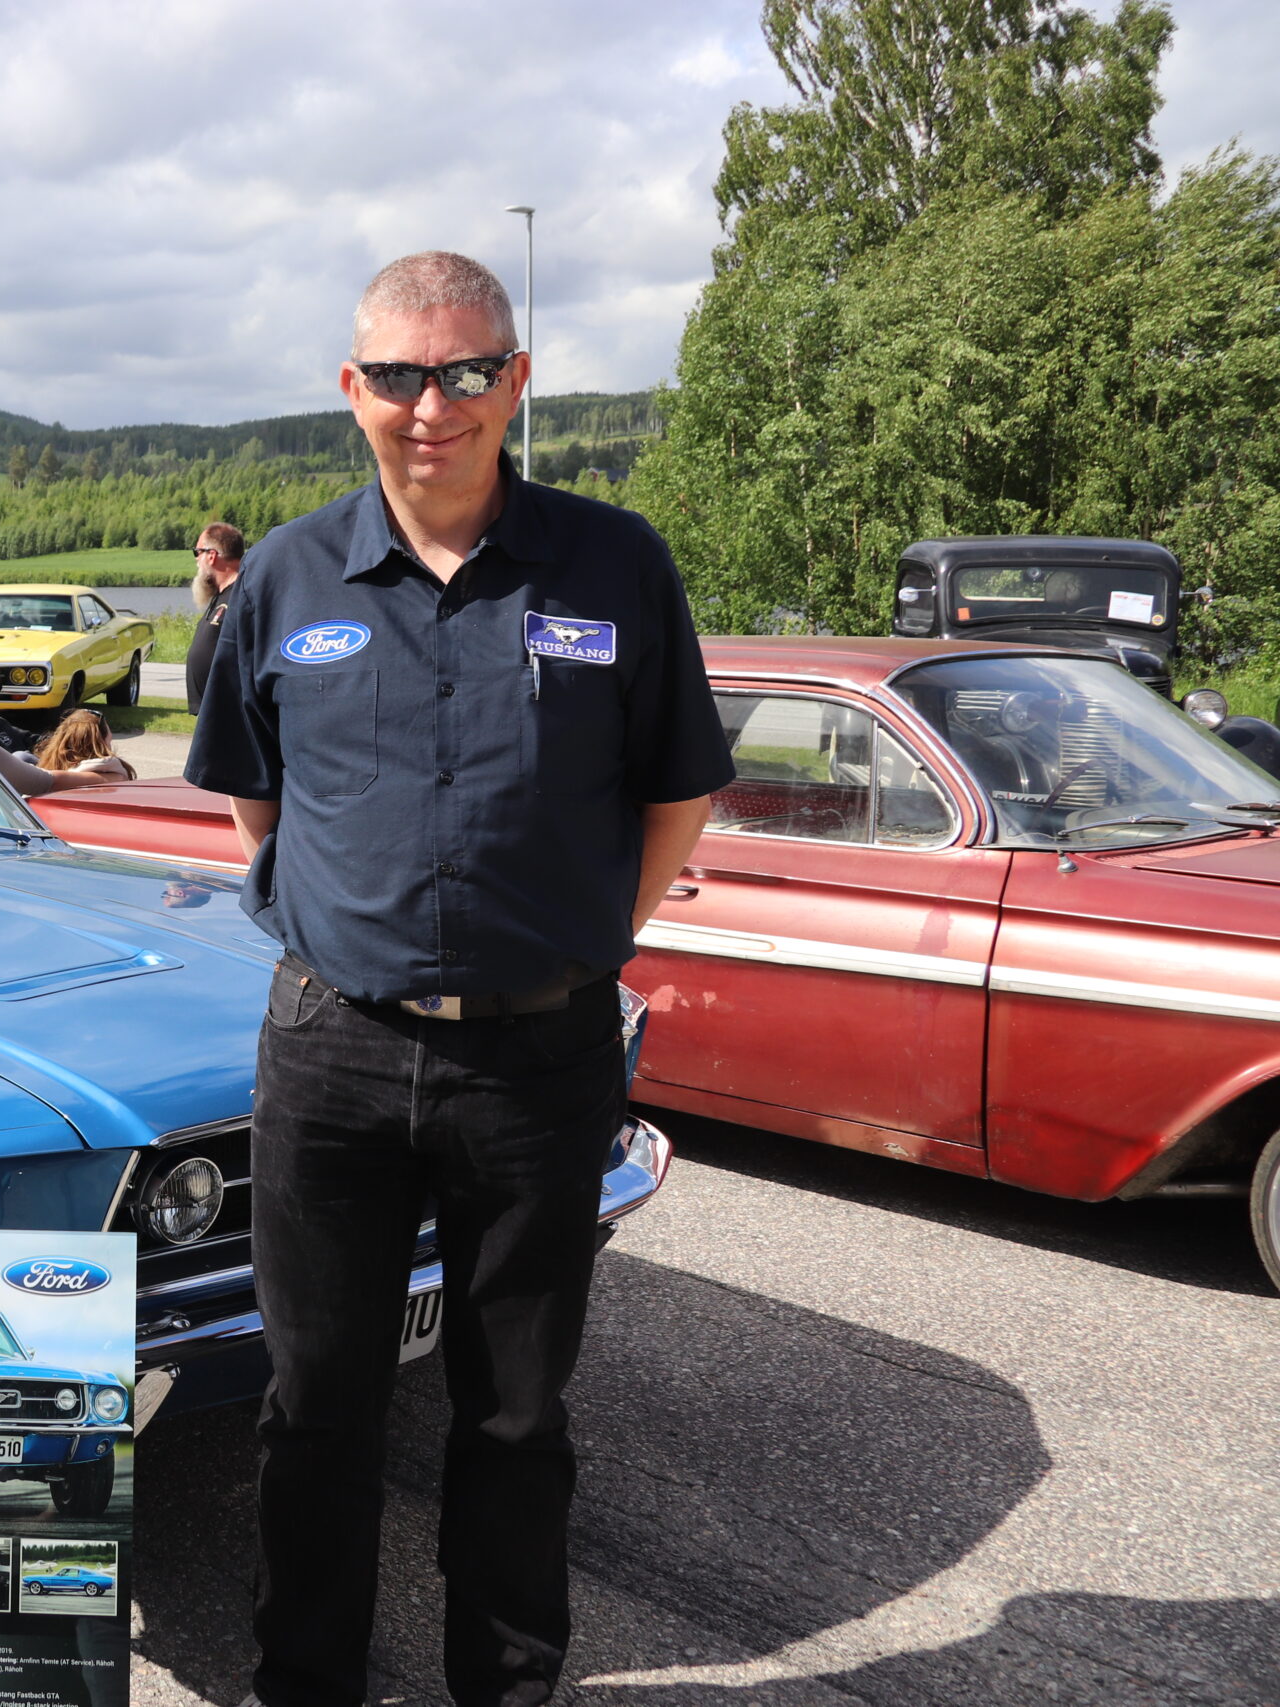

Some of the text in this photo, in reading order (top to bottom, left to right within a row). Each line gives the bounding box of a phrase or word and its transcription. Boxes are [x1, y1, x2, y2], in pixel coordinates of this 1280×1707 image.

[301, 629, 350, 655] Ford
[529, 639, 611, 660] MUSTANG
[23, 1261, 90, 1289] Ford
[17, 1691, 45, 1699] Fastback
[46, 1692, 60, 1700] GTA
